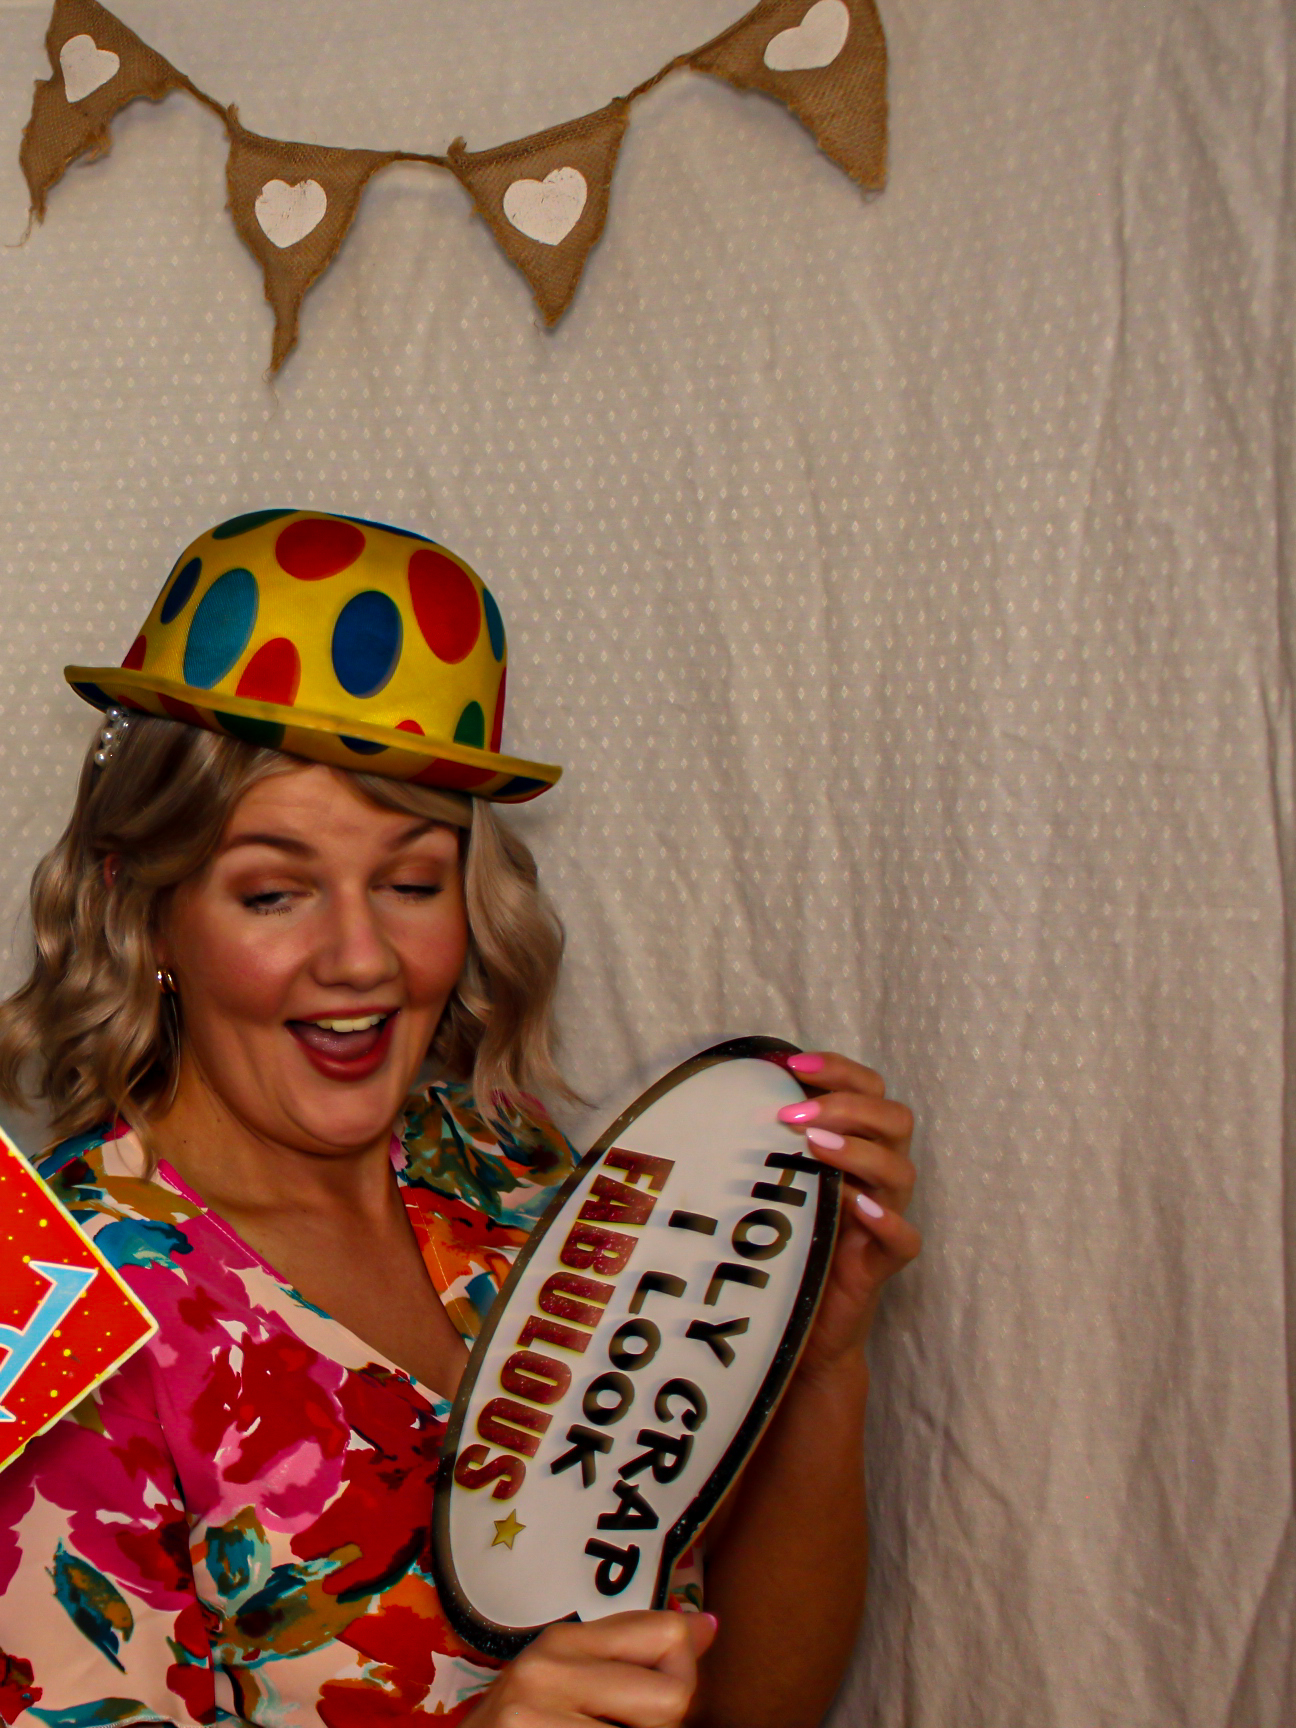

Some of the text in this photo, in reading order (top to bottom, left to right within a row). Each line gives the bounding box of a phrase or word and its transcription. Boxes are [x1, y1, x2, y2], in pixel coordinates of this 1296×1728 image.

[453, 1145, 676, 1502] FABULOUS
[550, 1209, 719, 1490] I LOOK
[584, 1151, 822, 1597] HOLY CRAP
